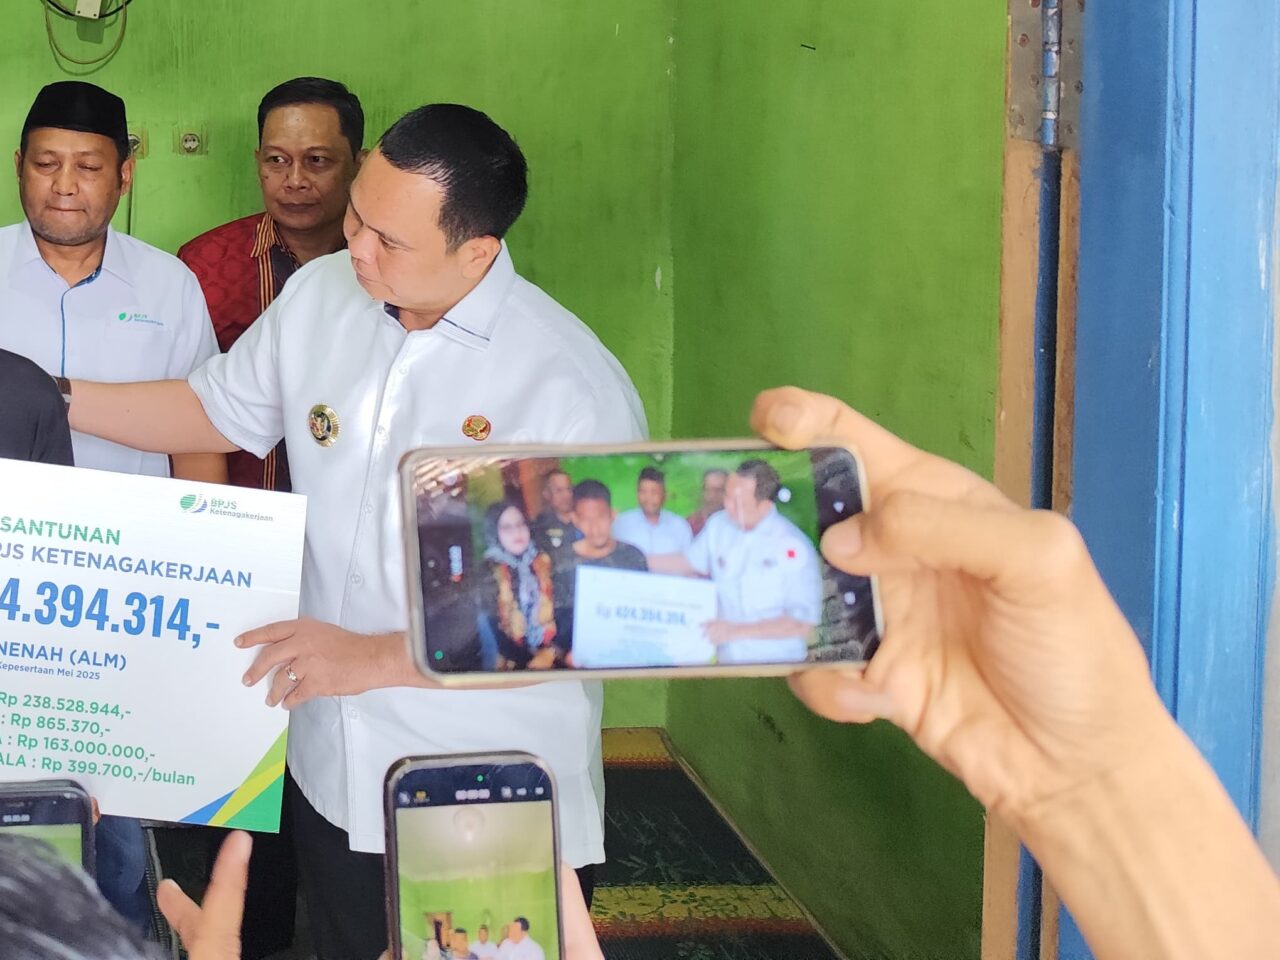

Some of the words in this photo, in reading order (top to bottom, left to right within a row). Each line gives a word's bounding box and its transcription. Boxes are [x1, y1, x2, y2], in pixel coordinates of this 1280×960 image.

[210, 498, 237, 510] BPJS
[0, 516, 120, 546] SANTUNAN
[31, 546, 252, 588] KETENAGAKERJAAN
[70, 649, 127, 671] (ALM)
[57, 668, 74, 678] Mei
[76, 670, 101, 680] 2025
[22, 694, 131, 720] 238.528.944,-
[10, 713, 32, 729] Rp
[36, 715, 111, 738] 865.370,-
[17, 733, 39, 750] Rp
[44, 737, 156, 763] 163.000.000,-
[41, 756, 63, 774] Rp
[67, 759, 196, 786] 399.700,-/bulan
